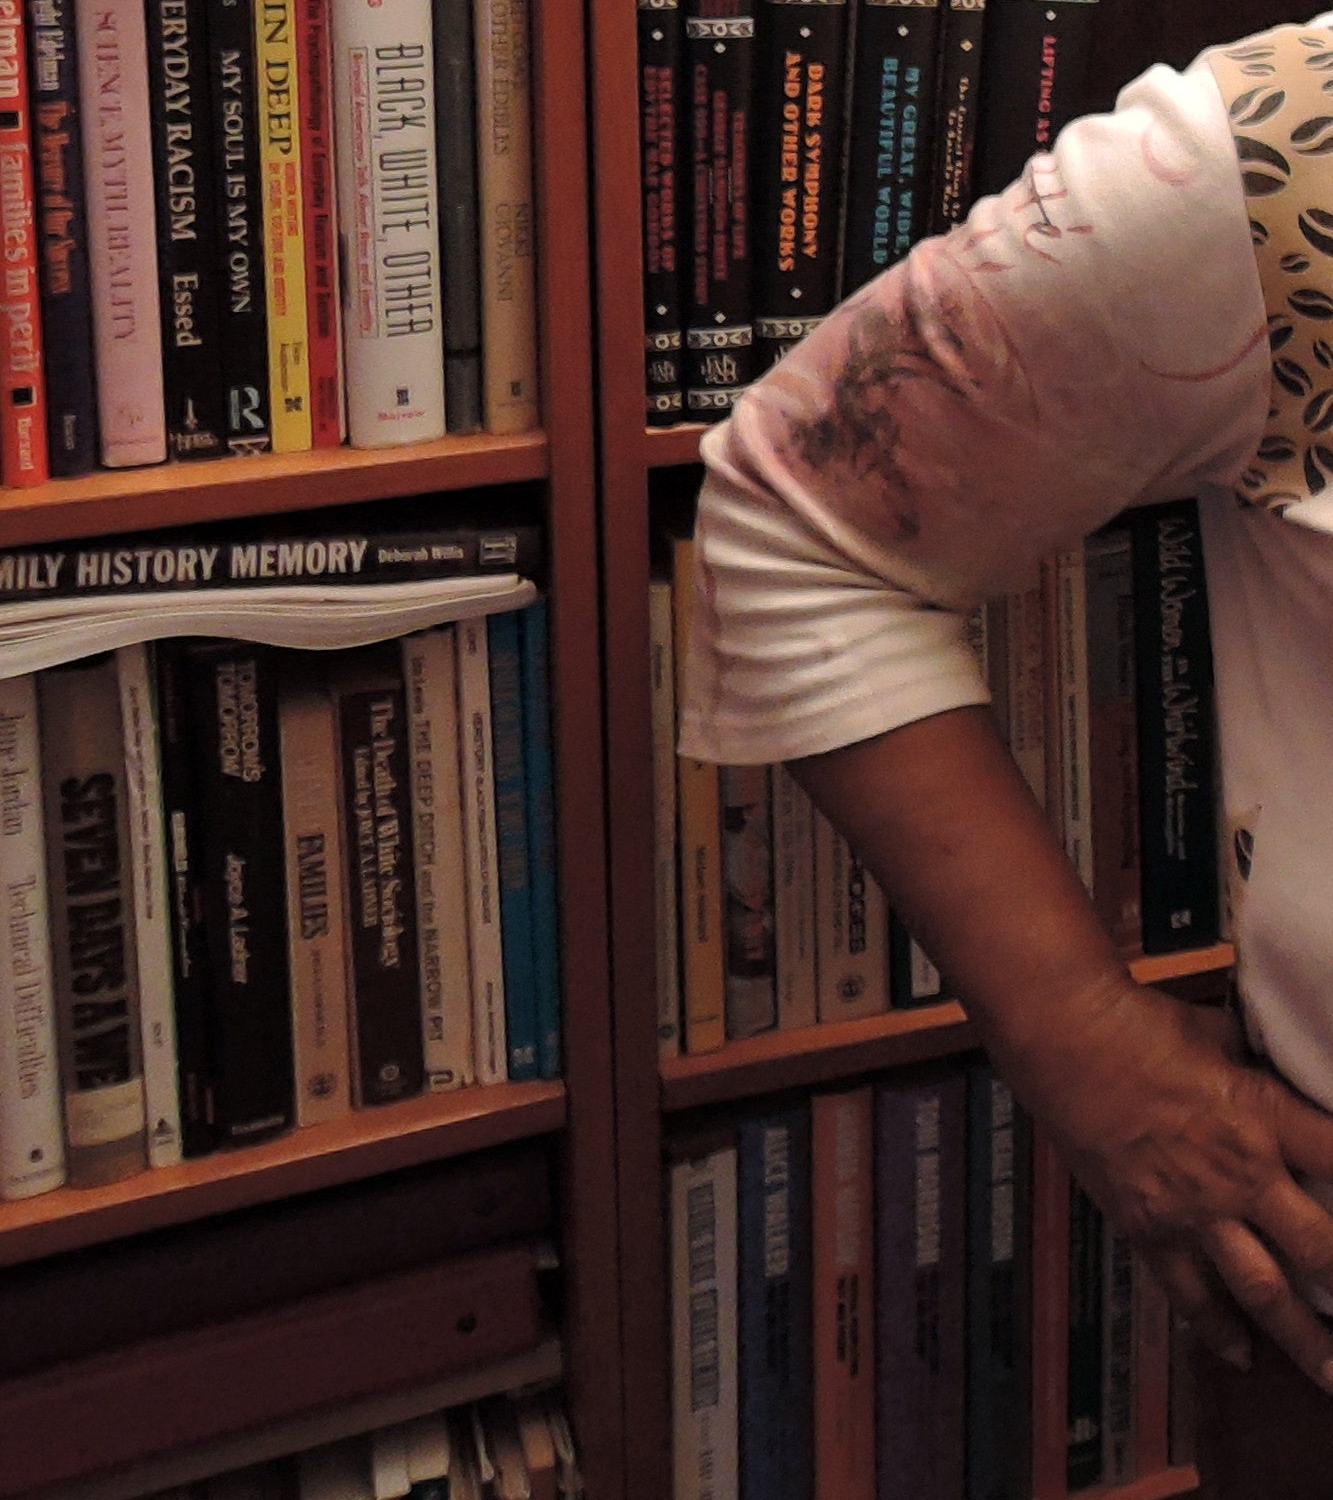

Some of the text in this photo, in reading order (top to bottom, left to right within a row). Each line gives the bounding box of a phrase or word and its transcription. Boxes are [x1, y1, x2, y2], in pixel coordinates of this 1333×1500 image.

[264, 59, 292, 156] DEEP
[1037, 36, 1057, 113] LIFTING
[166, 123, 197, 241] RACISM
[219, 50, 251, 315] MY SOUL IS MY OWN
[373, 44, 434, 338] BLACK, WHITE, OTHER
[778, 51, 802, 272] AND OTHER WORKS
[800, 63, 825, 259] DARK SYMPHONY
[872, 56, 899, 265] BEAUTIFUL WORLD
[172, 273, 201, 347] Essed
[76, 540, 369, 587] HISTORY MEMORY
[60, 772, 126, 897] SEVEN
